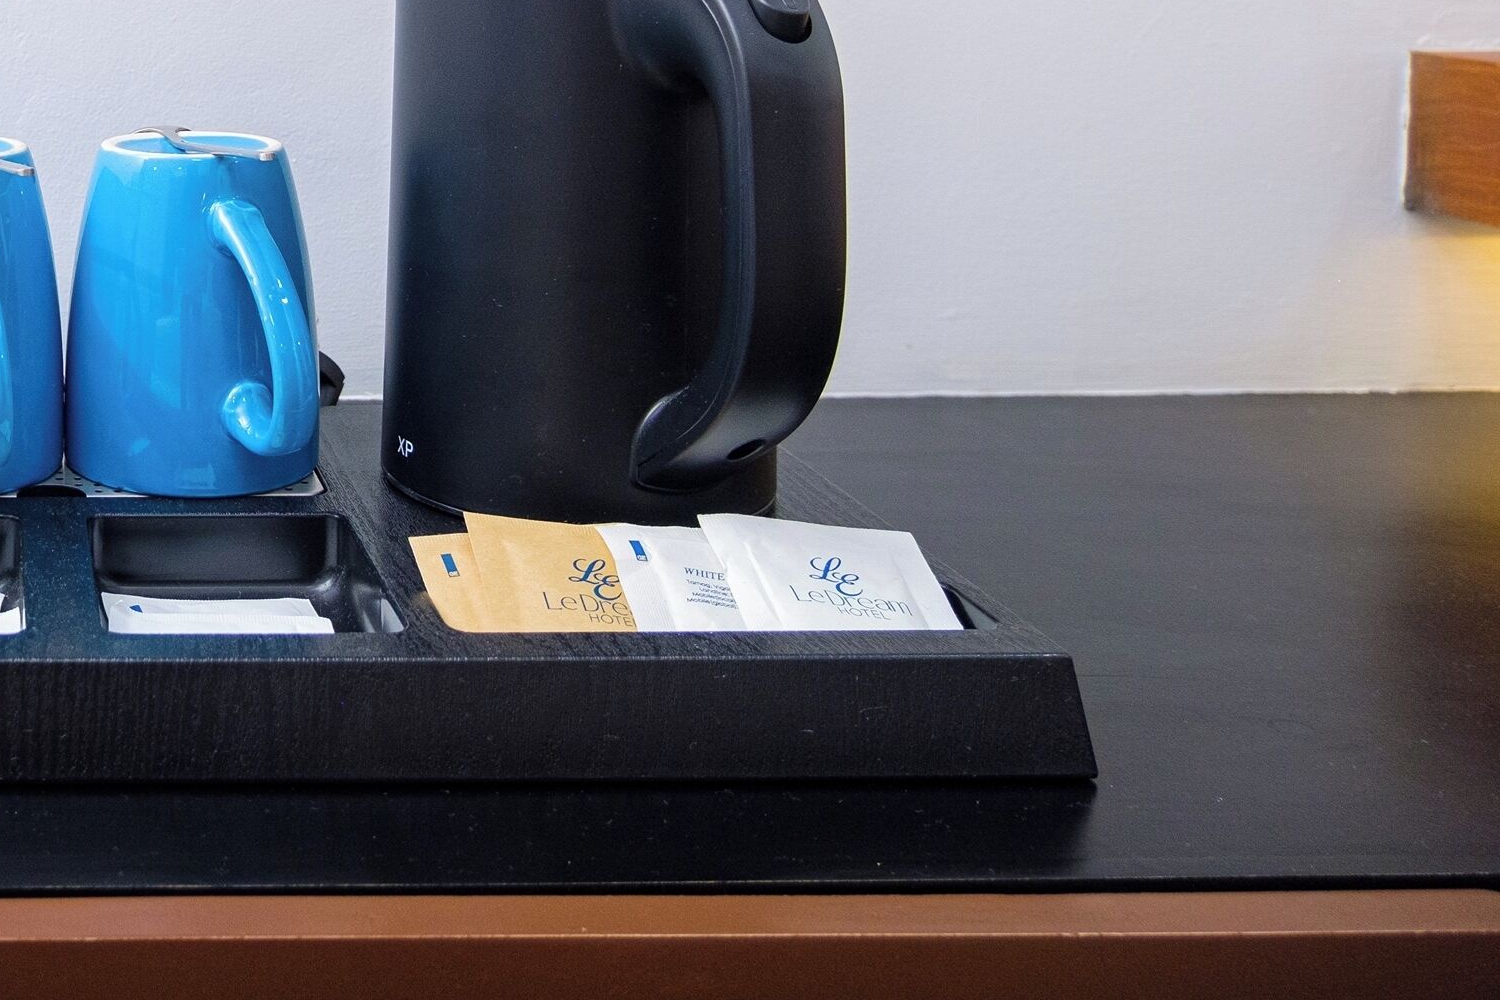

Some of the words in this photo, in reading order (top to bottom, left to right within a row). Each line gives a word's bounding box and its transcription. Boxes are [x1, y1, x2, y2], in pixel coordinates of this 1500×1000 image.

[397, 435, 414, 458] XP
[683, 566, 725, 581] WHITE
[542, 591, 633, 616] LeDre
[789, 584, 913, 617] LeDream
[836, 606, 892, 621] HOTEL
